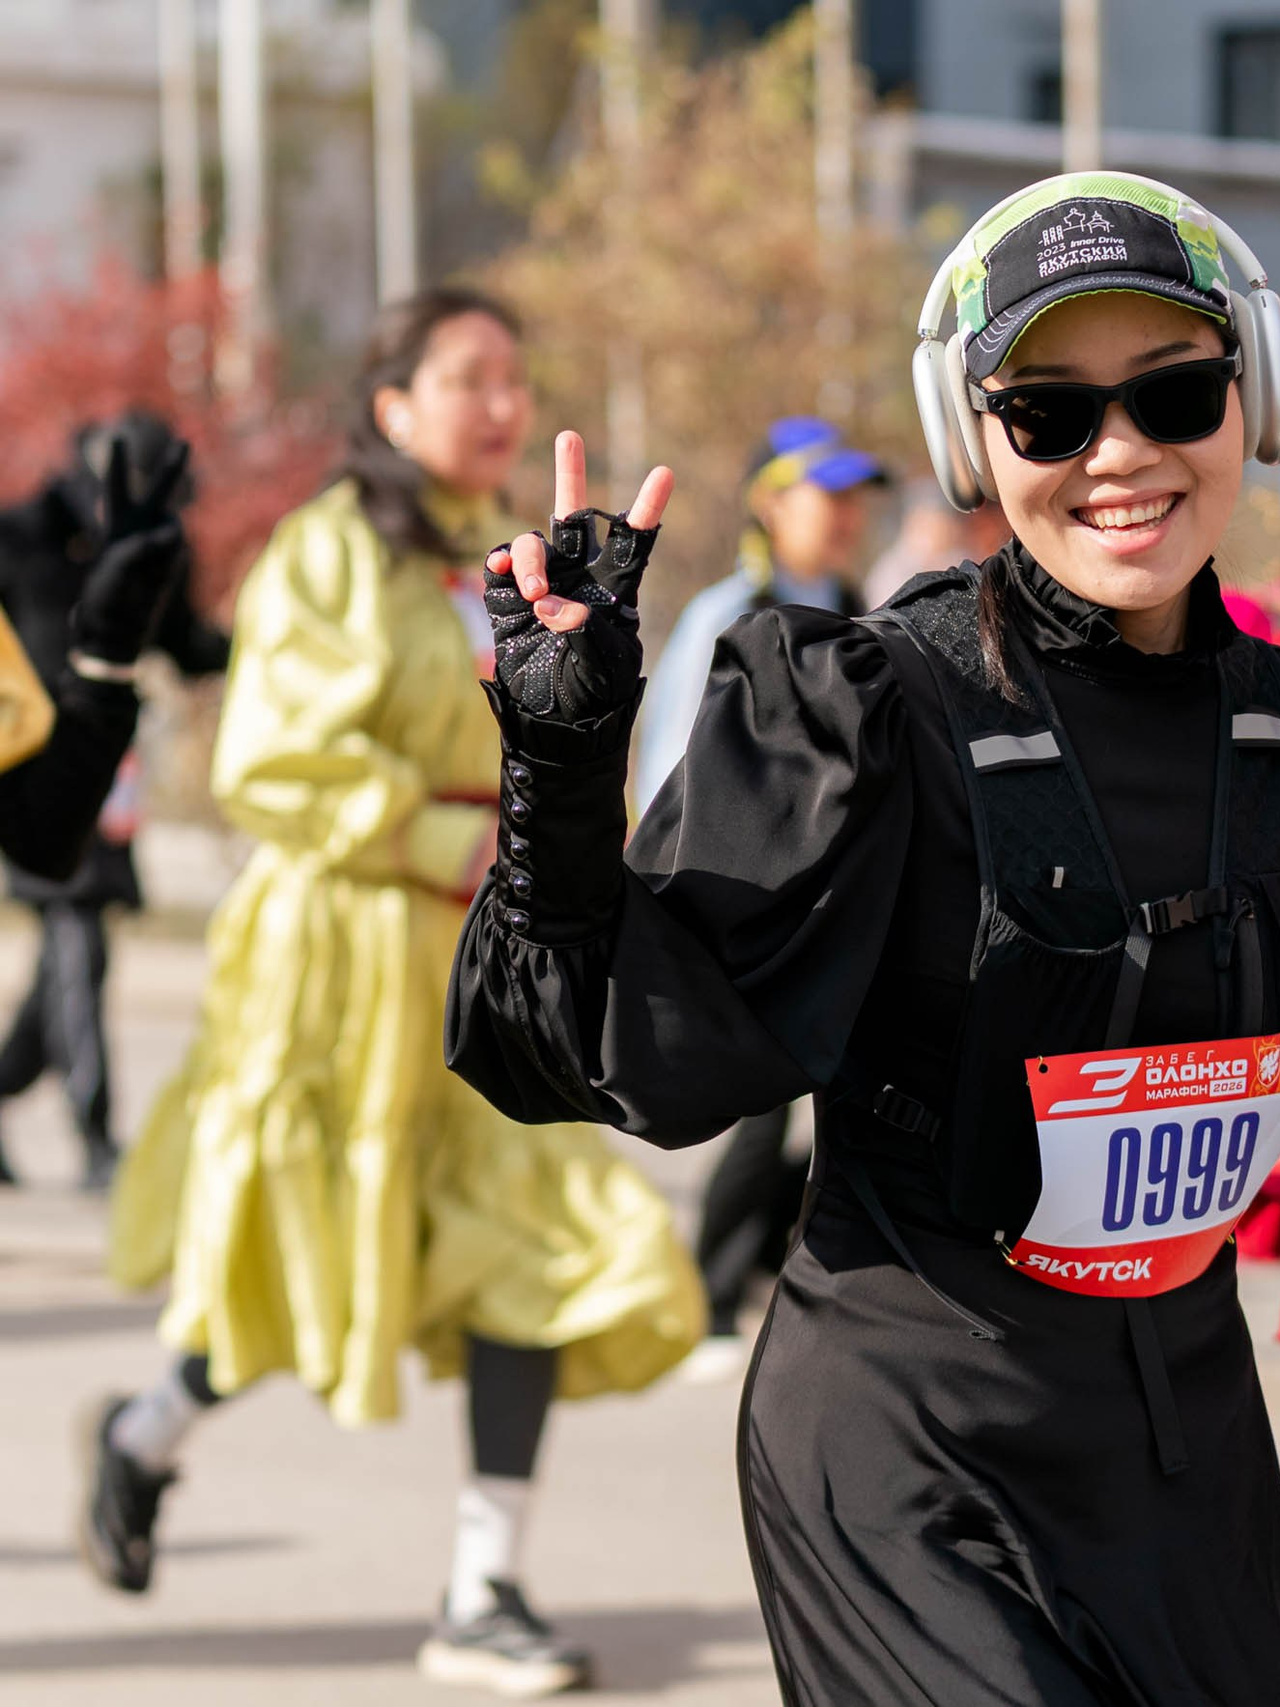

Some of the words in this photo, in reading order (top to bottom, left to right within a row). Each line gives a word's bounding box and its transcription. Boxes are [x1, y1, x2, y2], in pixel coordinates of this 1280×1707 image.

[1036, 242, 1066, 261] 2023
[1070, 237, 1096, 248] Inner
[1098, 236, 1125, 244] Drive
[1038, 245, 1127, 272] ЯКУТСКИЙ
[1039, 252, 1128, 278] ПОЛУМАРАФОН
[1145, 1050, 1215, 1066] ЗАБЕГ
[1145, 1058, 1248, 1085] ОЛОНХО
[1145, 1084, 1208, 1101] МАРАФОН
[1212, 1082, 1243, 1093] 2026
[1102, 1111, 1260, 1232] 0999
[1025, 1254, 1153, 1282] ЯКУТСК
